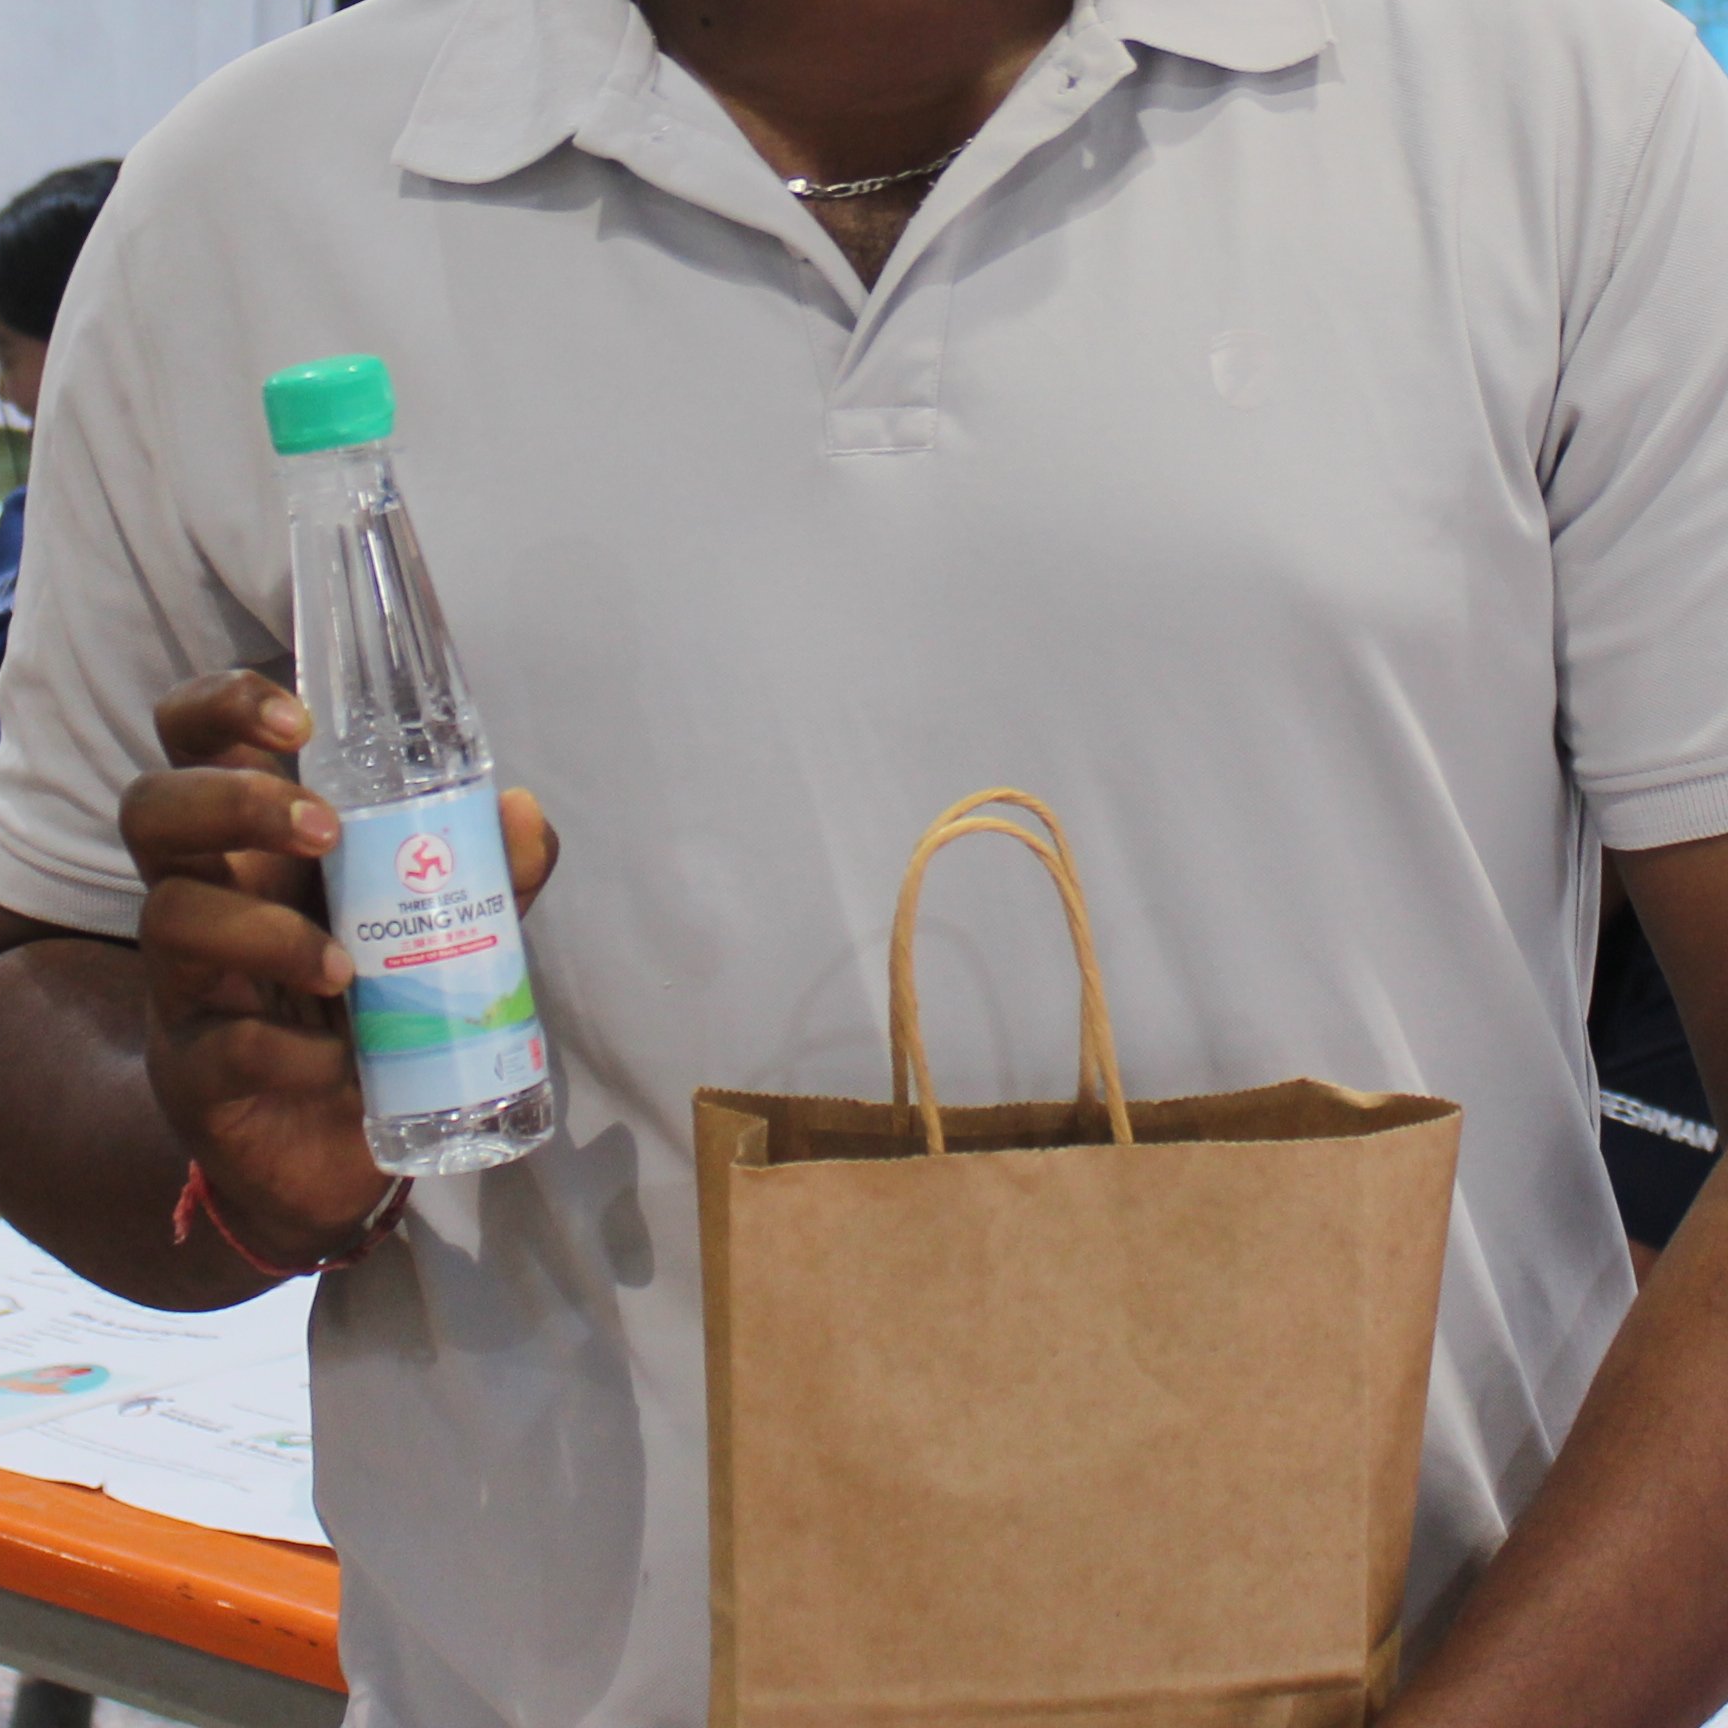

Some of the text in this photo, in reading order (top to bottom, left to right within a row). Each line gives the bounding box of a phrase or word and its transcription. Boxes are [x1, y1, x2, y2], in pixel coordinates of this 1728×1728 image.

[357, 911, 452, 942] COOLING
[456, 894, 505, 923] WATER
[398, 890, 468, 913] THREE LEGS
